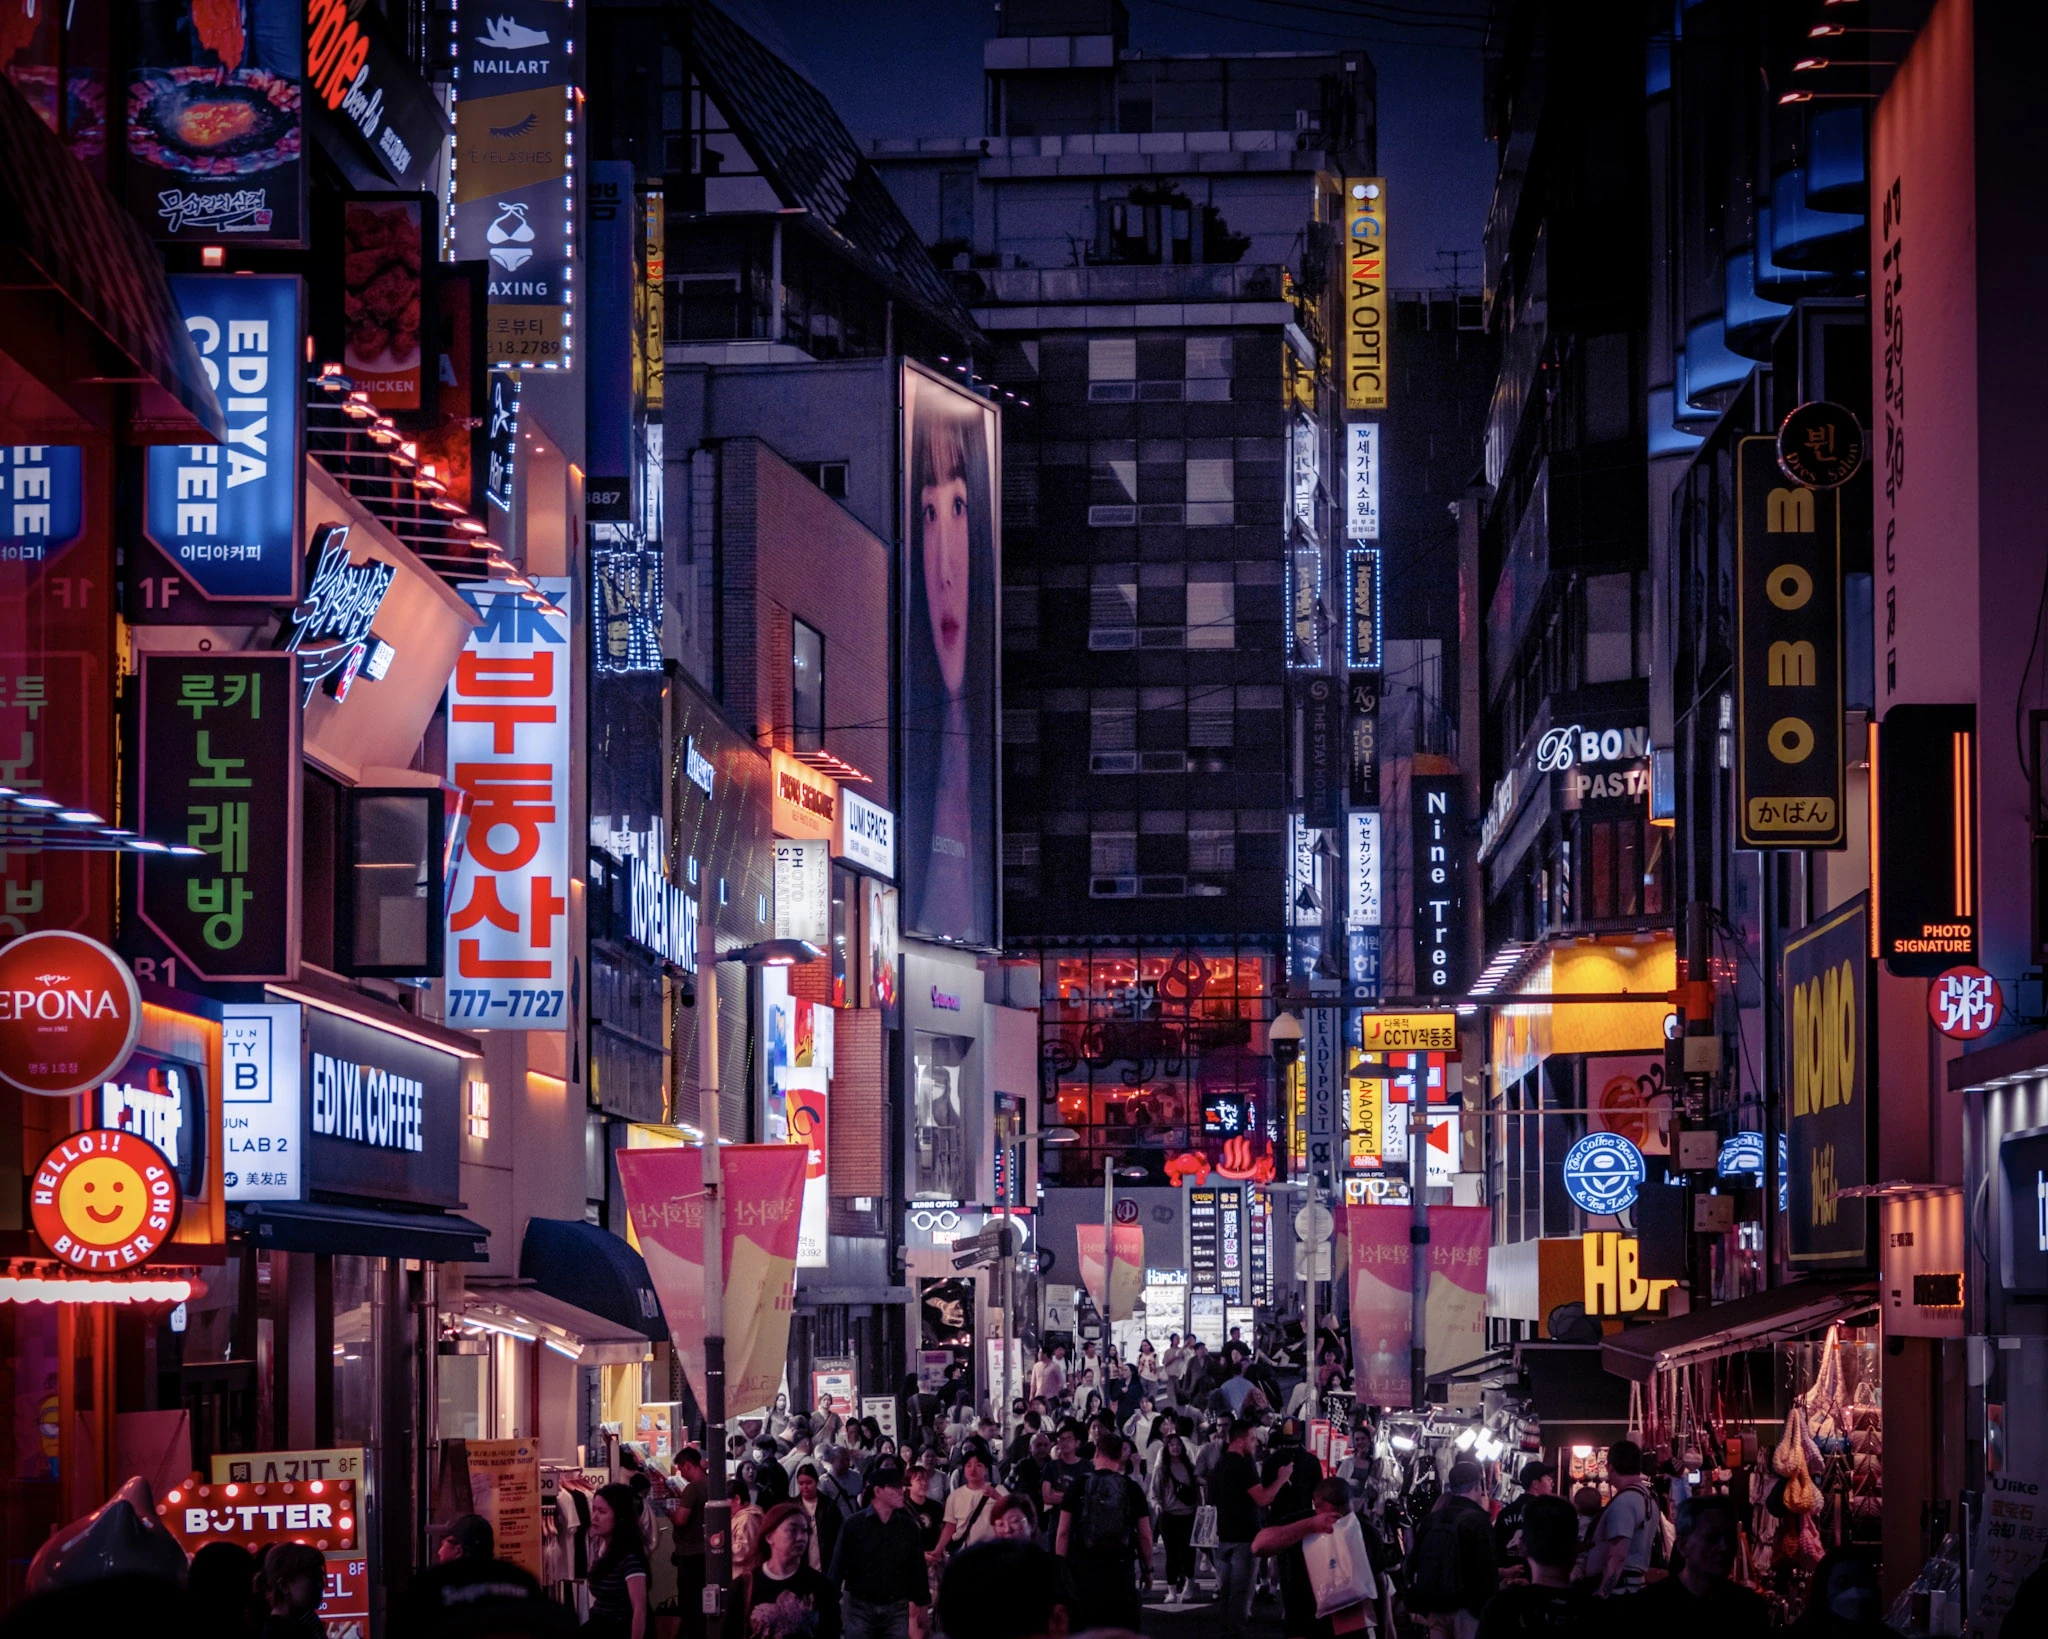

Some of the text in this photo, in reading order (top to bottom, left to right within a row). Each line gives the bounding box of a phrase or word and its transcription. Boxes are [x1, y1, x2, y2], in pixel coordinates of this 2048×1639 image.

[473, 60, 549, 74] NAILART
[471, 151, 553, 163] EYELASHES
[487, 281, 548, 296] AXING
[1351, 217, 1381, 391] GANA OPTIC
[488, 318, 544, 335] 로뷰티
[226, 320, 269, 489] EDIYA
[1356, 440, 1371, 516] 세가지소원
[180, 544, 262, 562] 이디야커피
[138, 576, 181, 609] 1F
[1765, 487, 1817, 764] momo
[177, 672, 261, 720] 루키
[1361, 719, 1374, 794] HOTEL
[1580, 726, 1651, 763] BON
[449, 651, 565, 979] 부동산
[866, 809, 888, 847] SPACE
[1757, 800, 1829, 825] かばん
[186, 730, 254, 950] 노래방
[777, 847, 790, 938] SIGNATURE
[791, 847, 803, 904] PHOTO
[1427, 791, 1451, 986] Nine Tree
[1894, 939, 1972, 954] SIGNATURE
[1922, 925, 1972, 939] PHOTO
[449, 989, 564, 1017] 777-7727
[1939, 974, 1994, 1031] 粥
[1384, 1018, 1410, 1029] 다목적
[1317, 1008, 1329, 1132] READYPOST
[312, 1052, 363, 1141] EDIYA
[366, 1066, 423, 1152] COFFEE
[230, 1138, 287, 1152] LAB 2
[1579, 1135, 1615, 1153] Coffee
[1615, 1138, 1638, 1170] Bean
[246, 1172, 288, 1186] 美发店
[145, 1165, 172, 1232] SHOP
[1586, 1195, 1606, 1210] Tea
[1606, 1185, 1634, 1209] Leaf
[54, 1234, 154, 1269] BUTTER
[338, 1457, 358, 1473] 8F
[1993, 1478, 2040, 1496] Ulike
[348, 1562, 366, 1577] 8F
